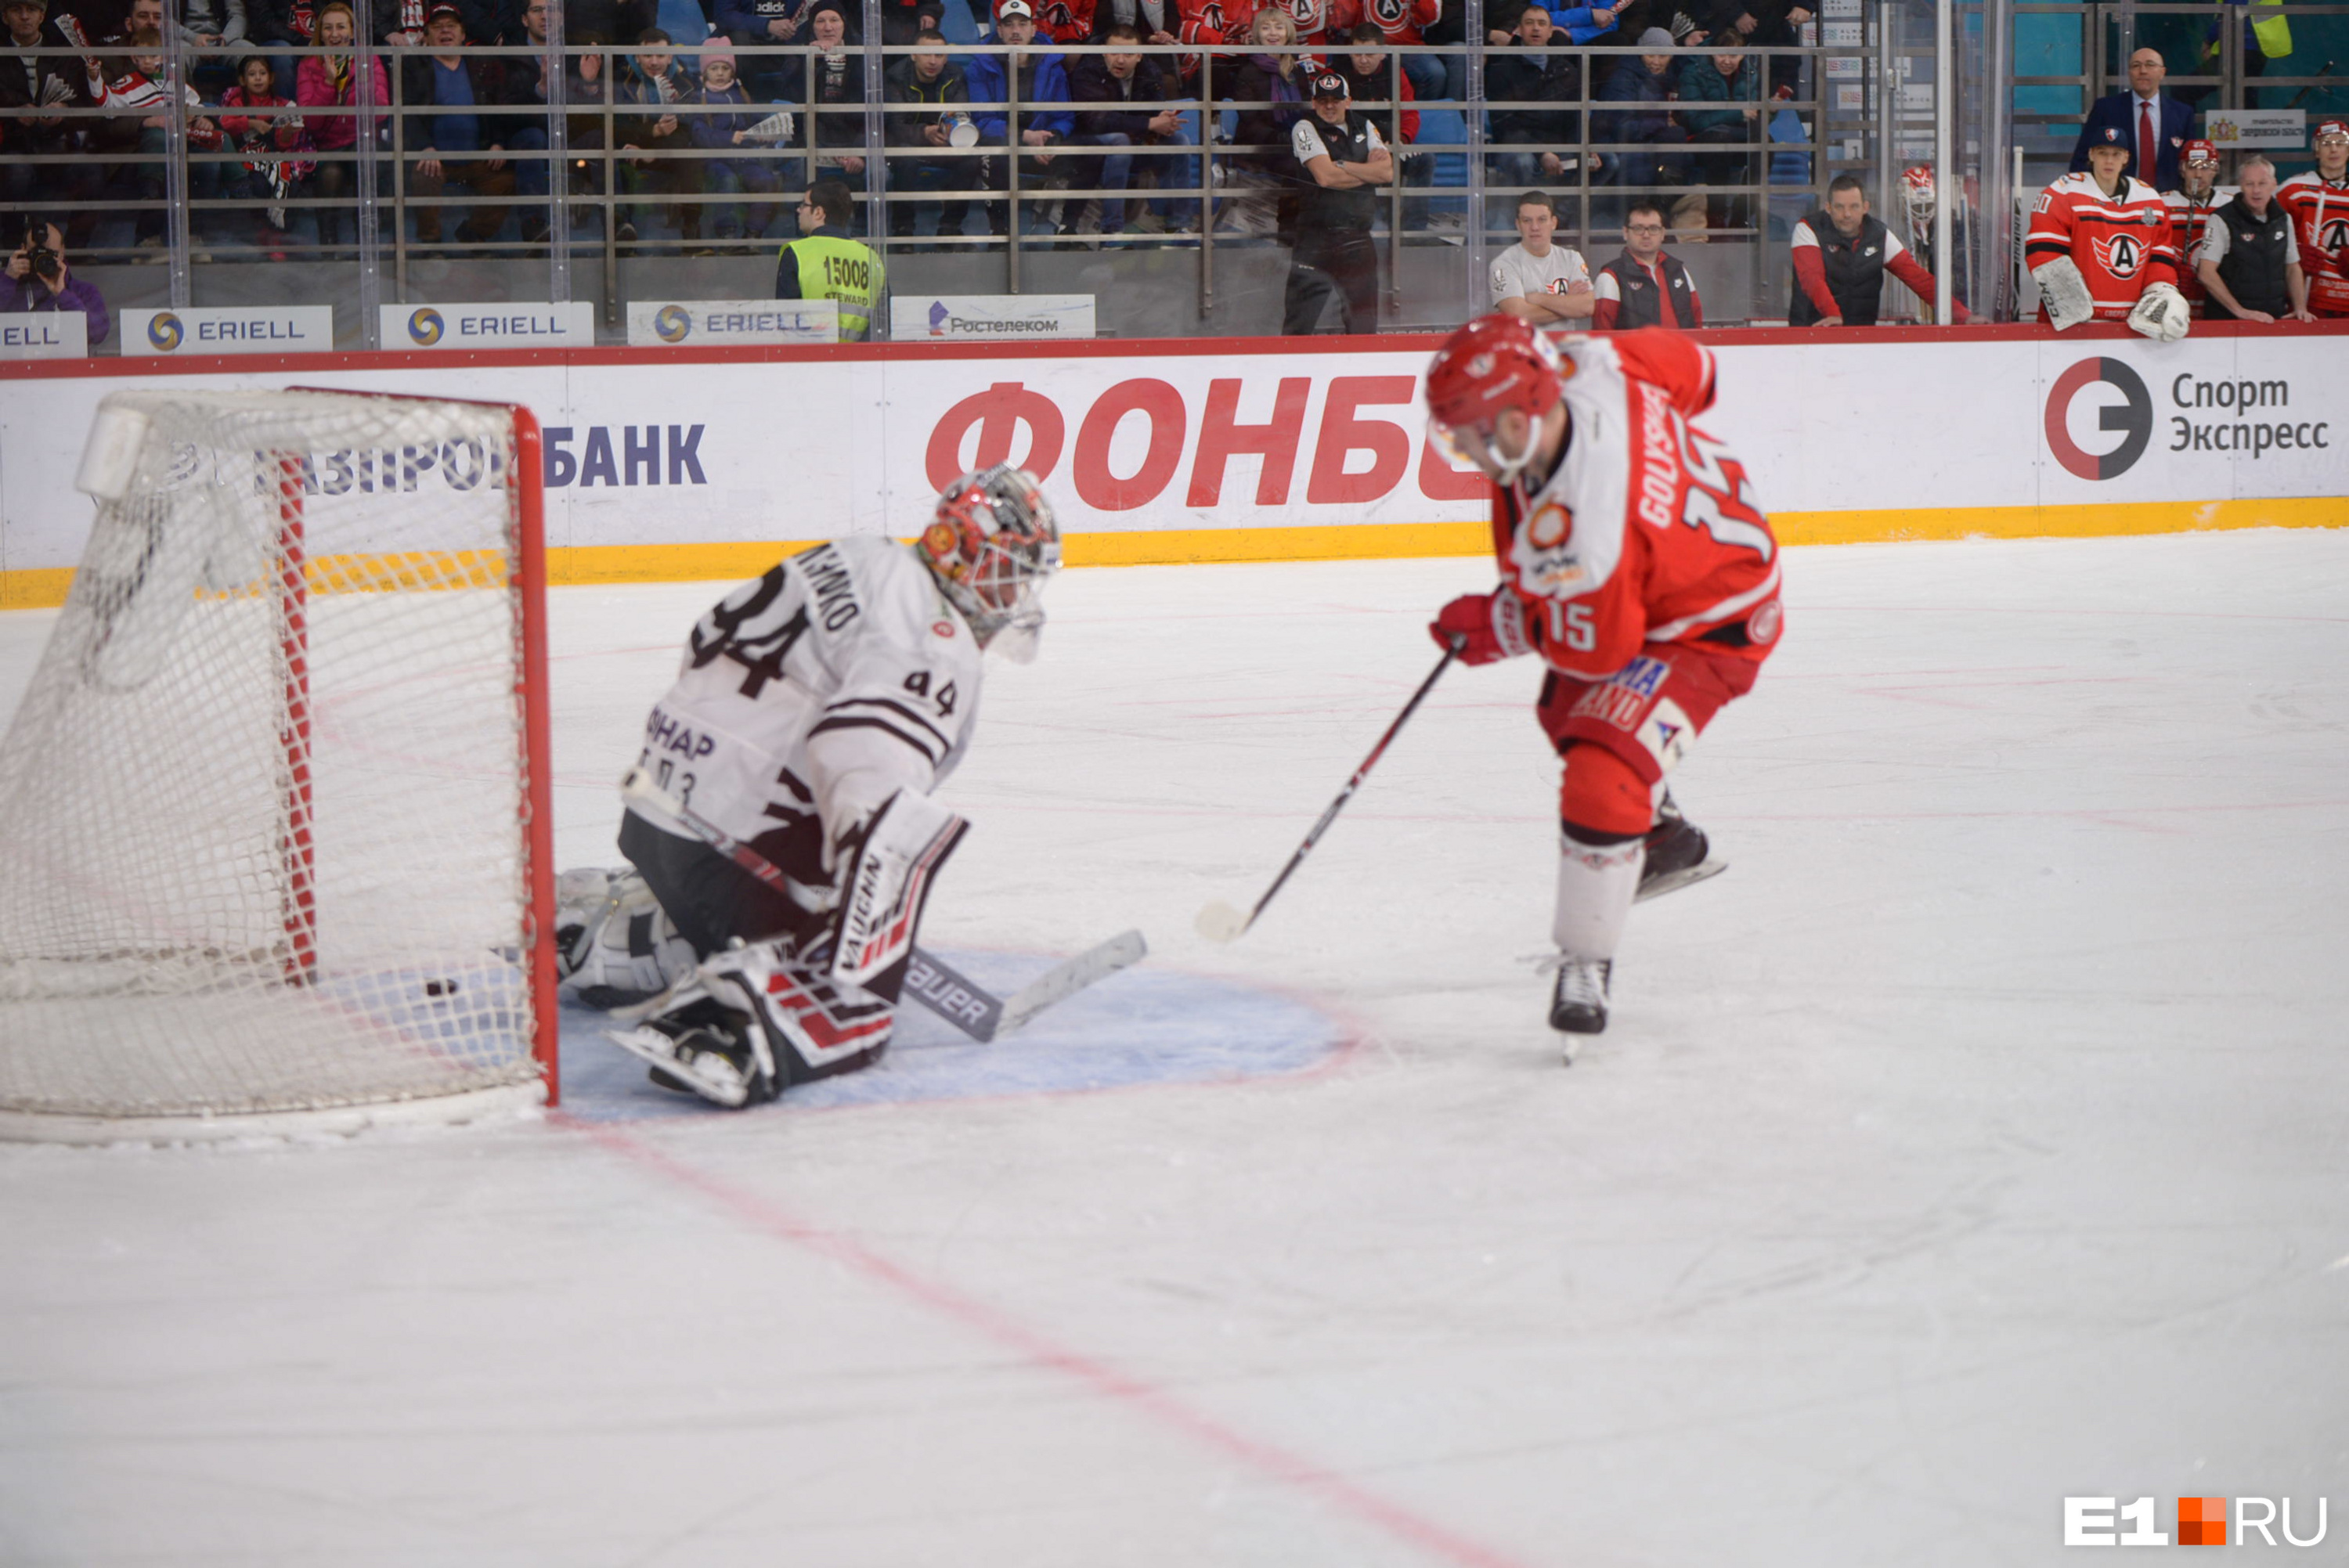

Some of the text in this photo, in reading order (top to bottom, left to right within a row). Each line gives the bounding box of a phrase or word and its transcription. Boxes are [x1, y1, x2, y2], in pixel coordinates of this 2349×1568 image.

[824, 256, 868, 290] 15008
[824, 292, 868, 306] STEWARD
[2039, 281, 2059, 319] CCM
[4, 326, 60, 346] ELL
[199, 321, 305, 341] ERIELL
[461, 316, 567, 335] ERIELL
[707, 314, 813, 333] ERIELL
[951, 317, 1059, 333] Ростелеком
[2173, 373, 2289, 416] Спорт
[2170, 416, 2329, 459] Экспресс
[1546, 600, 1596, 652] 15
[841, 855, 882, 971] VAUGHN
[907, 956, 990, 1025] AUER
